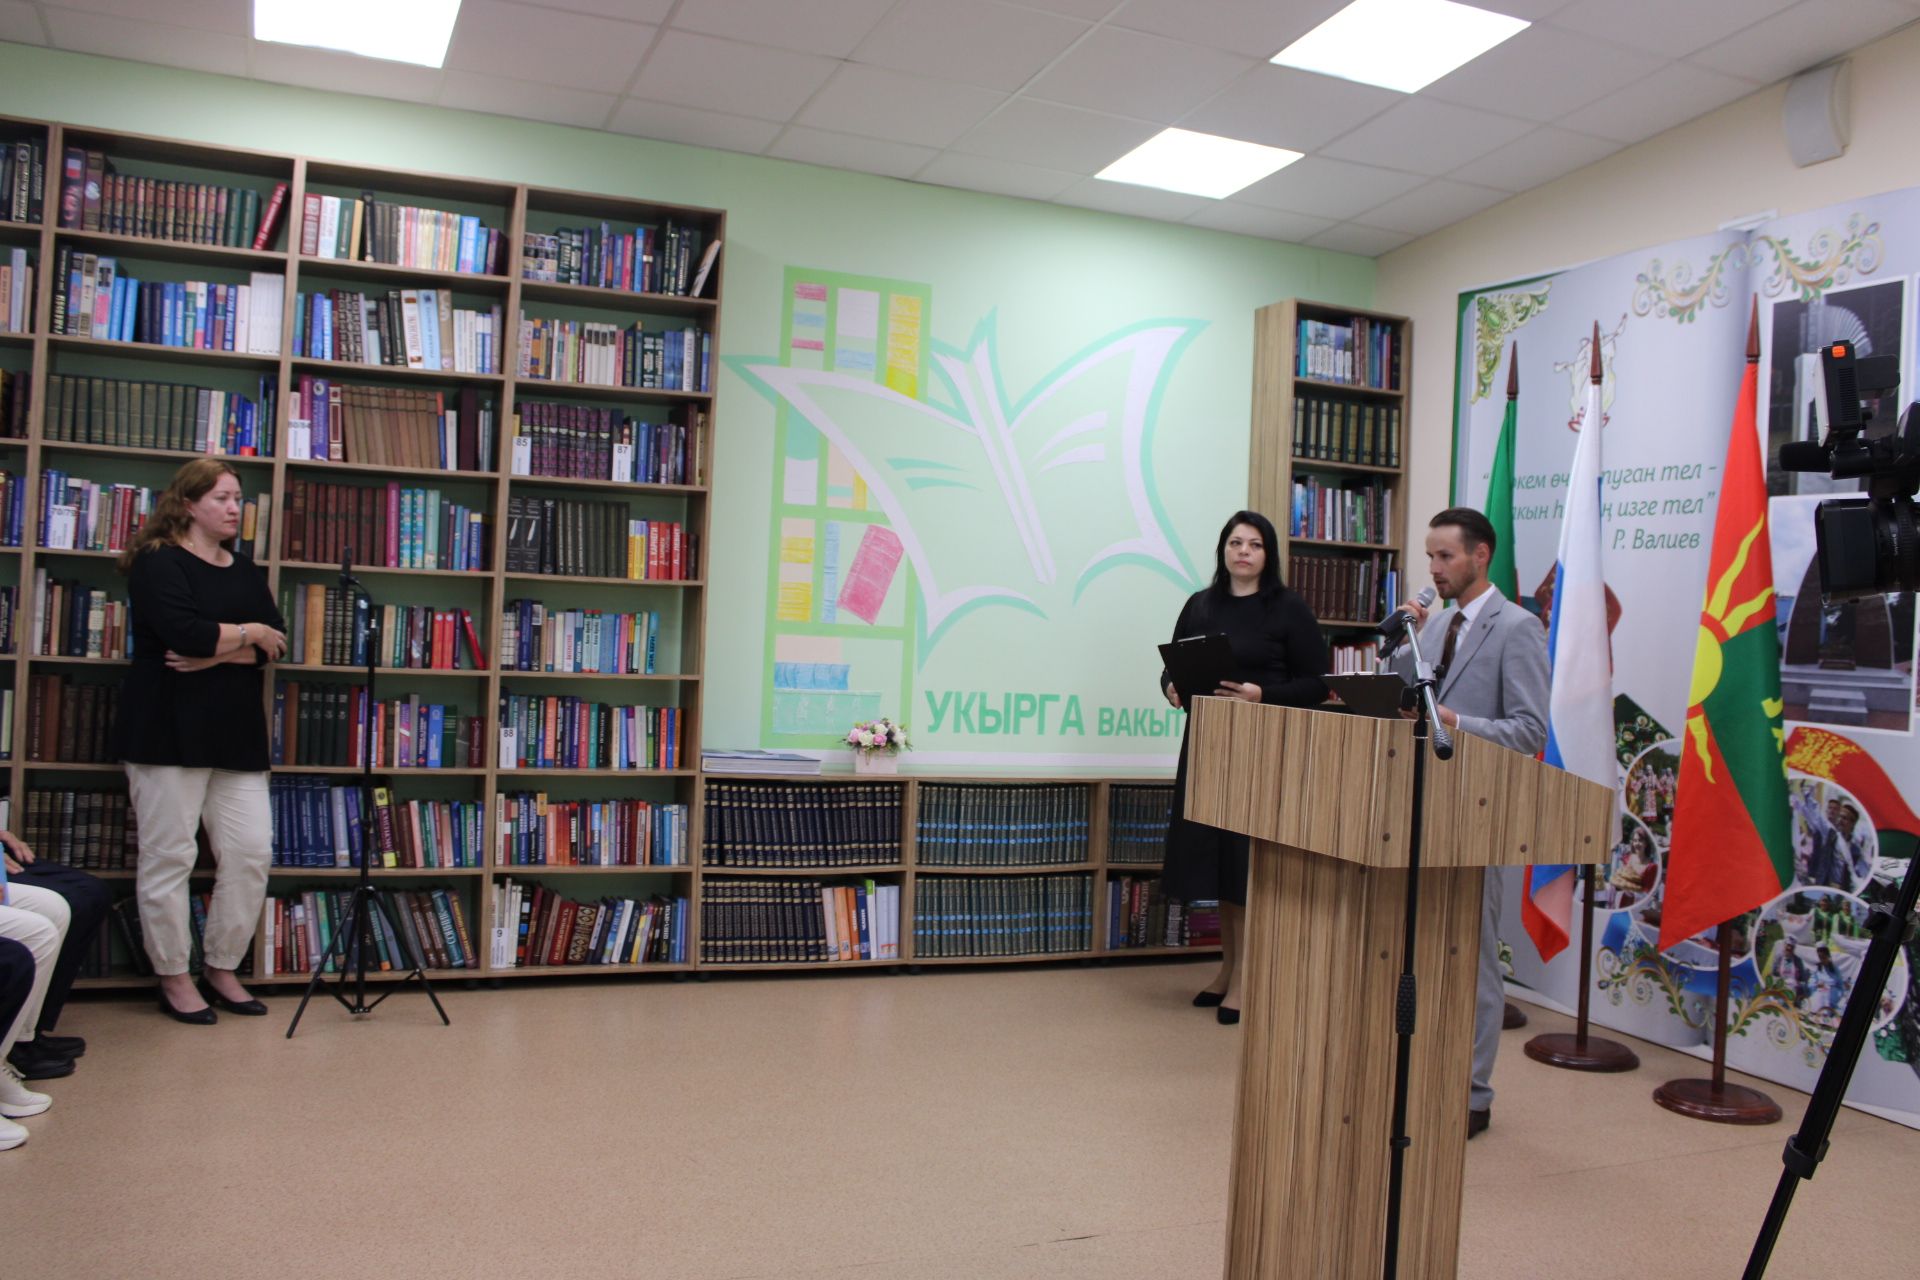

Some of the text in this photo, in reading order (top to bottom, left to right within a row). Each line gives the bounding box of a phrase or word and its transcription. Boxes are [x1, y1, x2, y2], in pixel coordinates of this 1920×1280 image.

[516, 437, 528, 447] 85
[616, 445, 629, 455] 87
[1660, 463, 1702, 482] тел
[1617, 500, 1659, 517] изге
[1613, 528, 1626, 550] Р.
[924, 690, 1186, 737] УКЫРГА ВАКЫТ
[503, 729, 514, 738] 88
